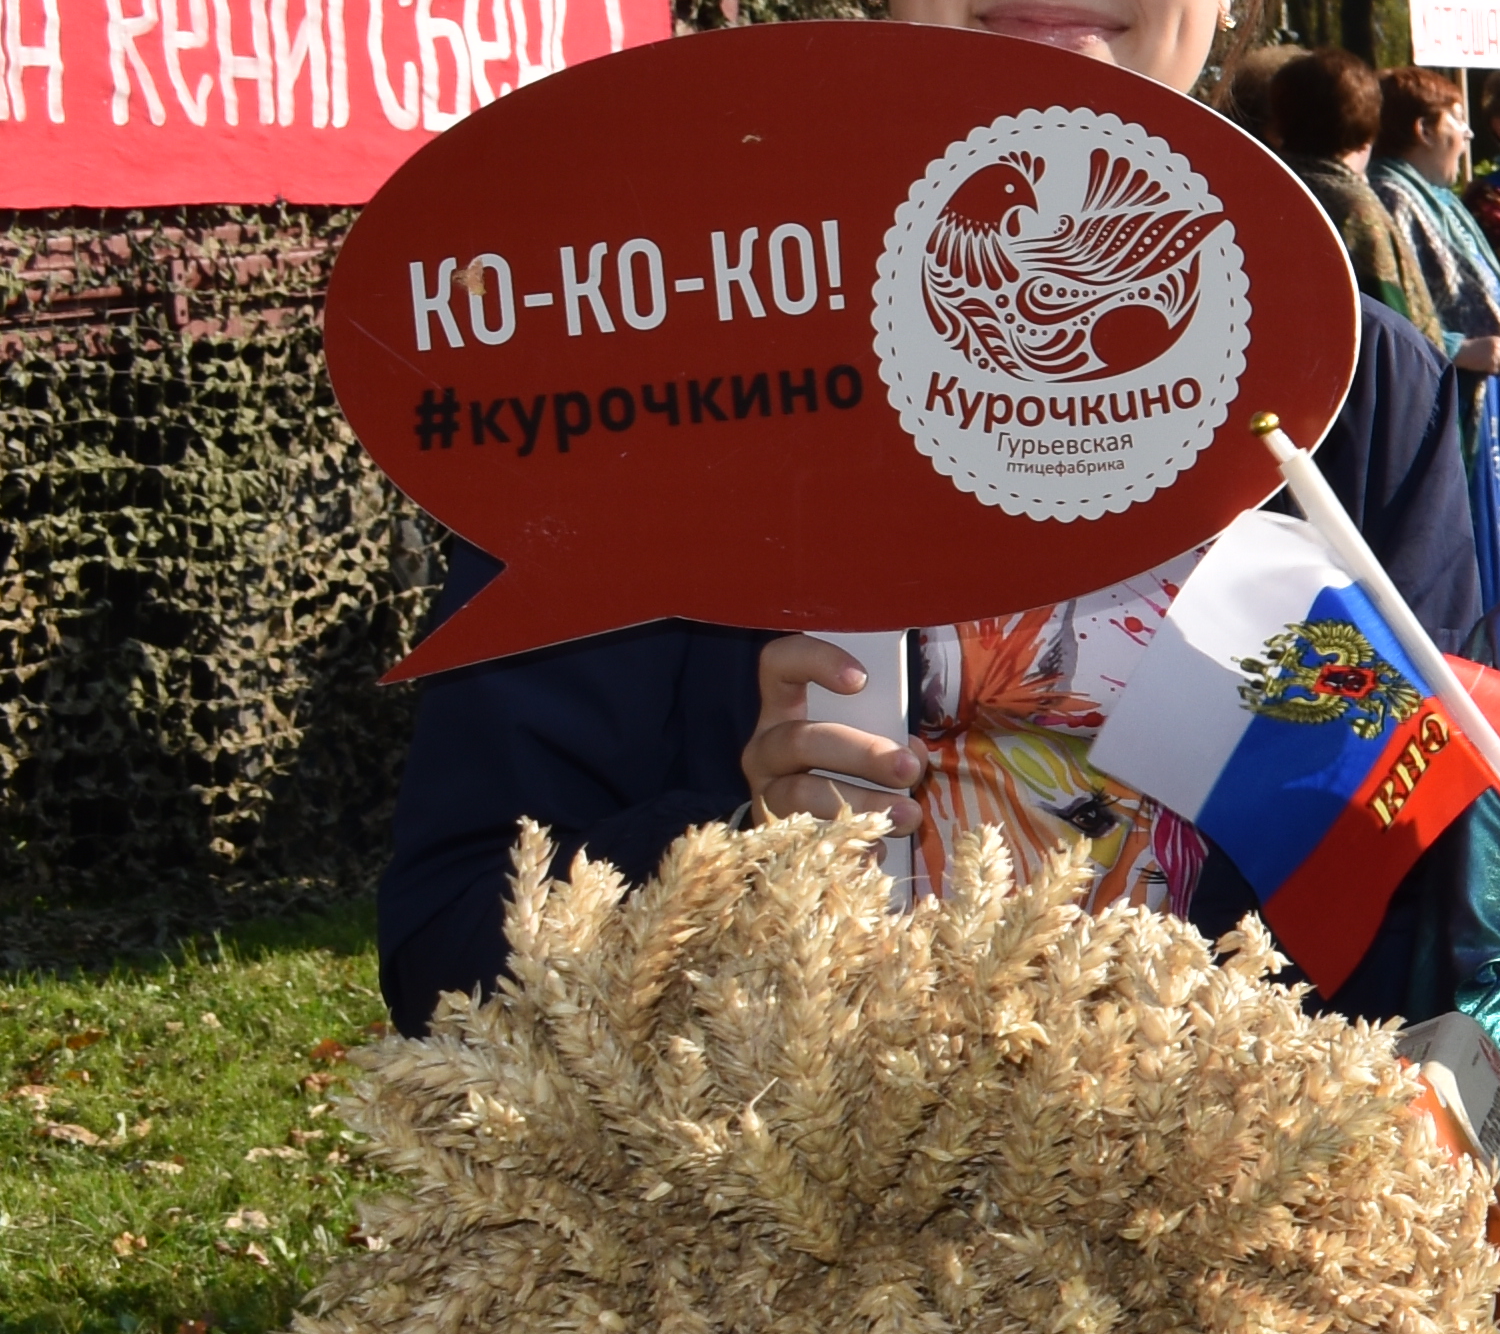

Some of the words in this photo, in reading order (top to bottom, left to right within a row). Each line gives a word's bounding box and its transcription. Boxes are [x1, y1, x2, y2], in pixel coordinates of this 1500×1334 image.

[408, 218, 847, 352] КО-КО-КО!
[414, 359, 864, 455] #курочкино
[924, 370, 1203, 436] Курочкино
[996, 429, 1135, 460] Гурьевская
[1004, 455, 1126, 478] птицефабрика
